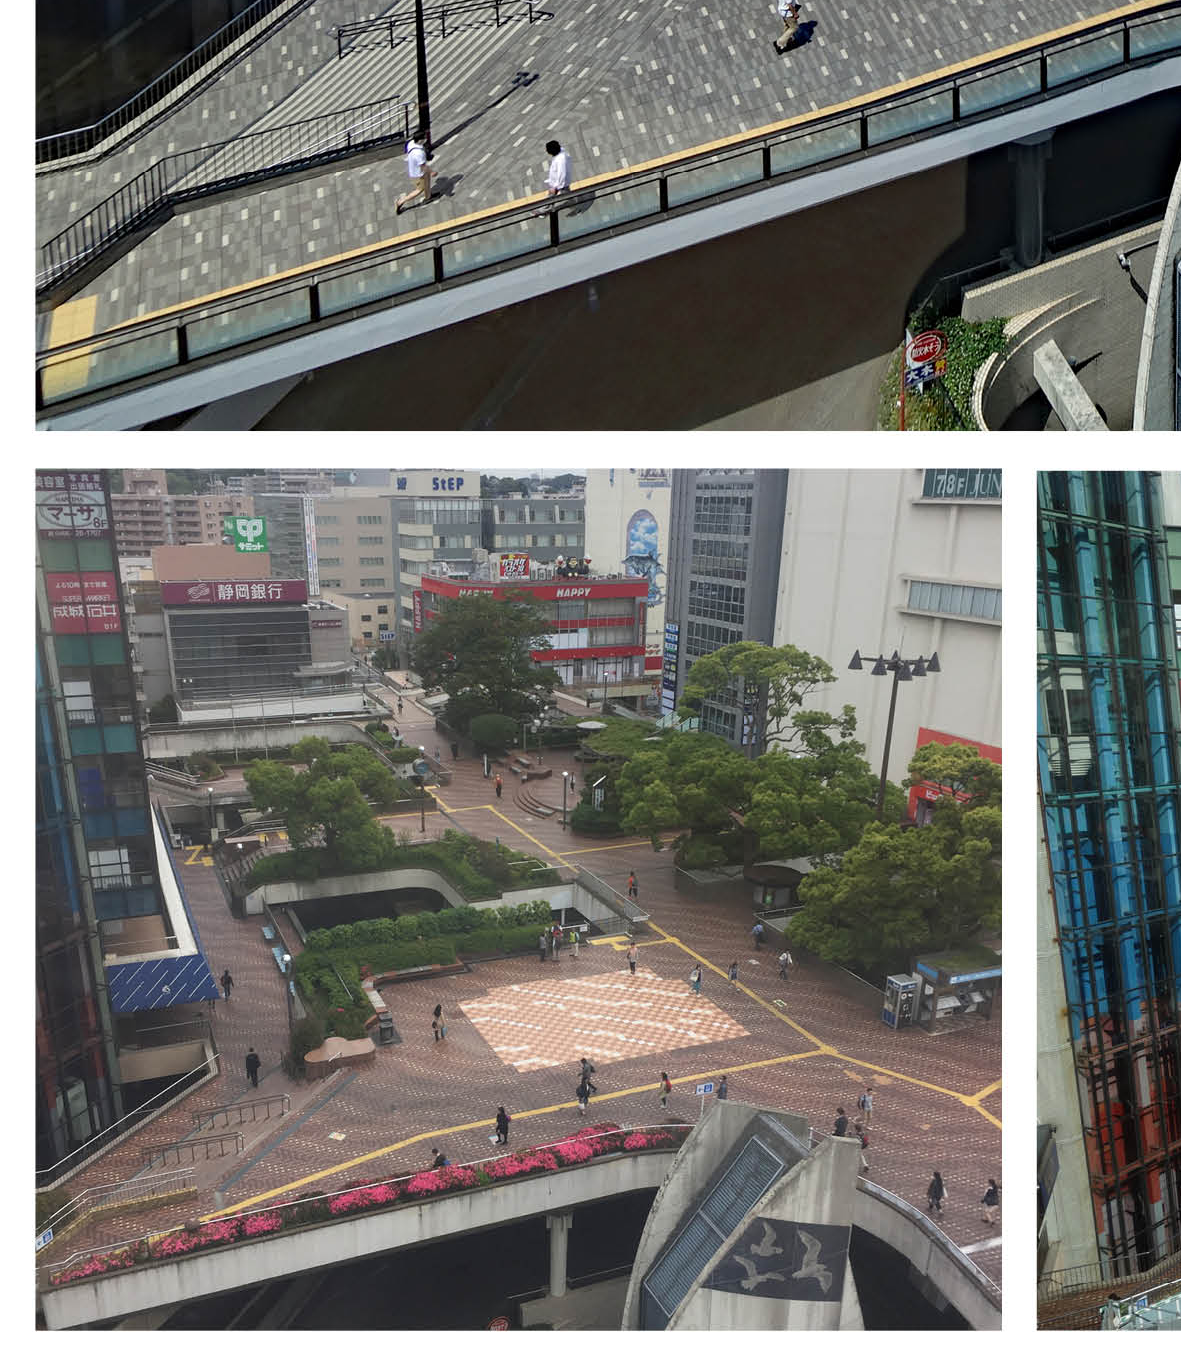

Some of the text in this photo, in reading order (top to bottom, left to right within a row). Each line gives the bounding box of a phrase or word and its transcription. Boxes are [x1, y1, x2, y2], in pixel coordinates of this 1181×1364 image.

[432, 477, 465, 491] StEP
[218, 583, 283, 600] 静岡銀行
[557, 587, 591, 598] HAPPY
